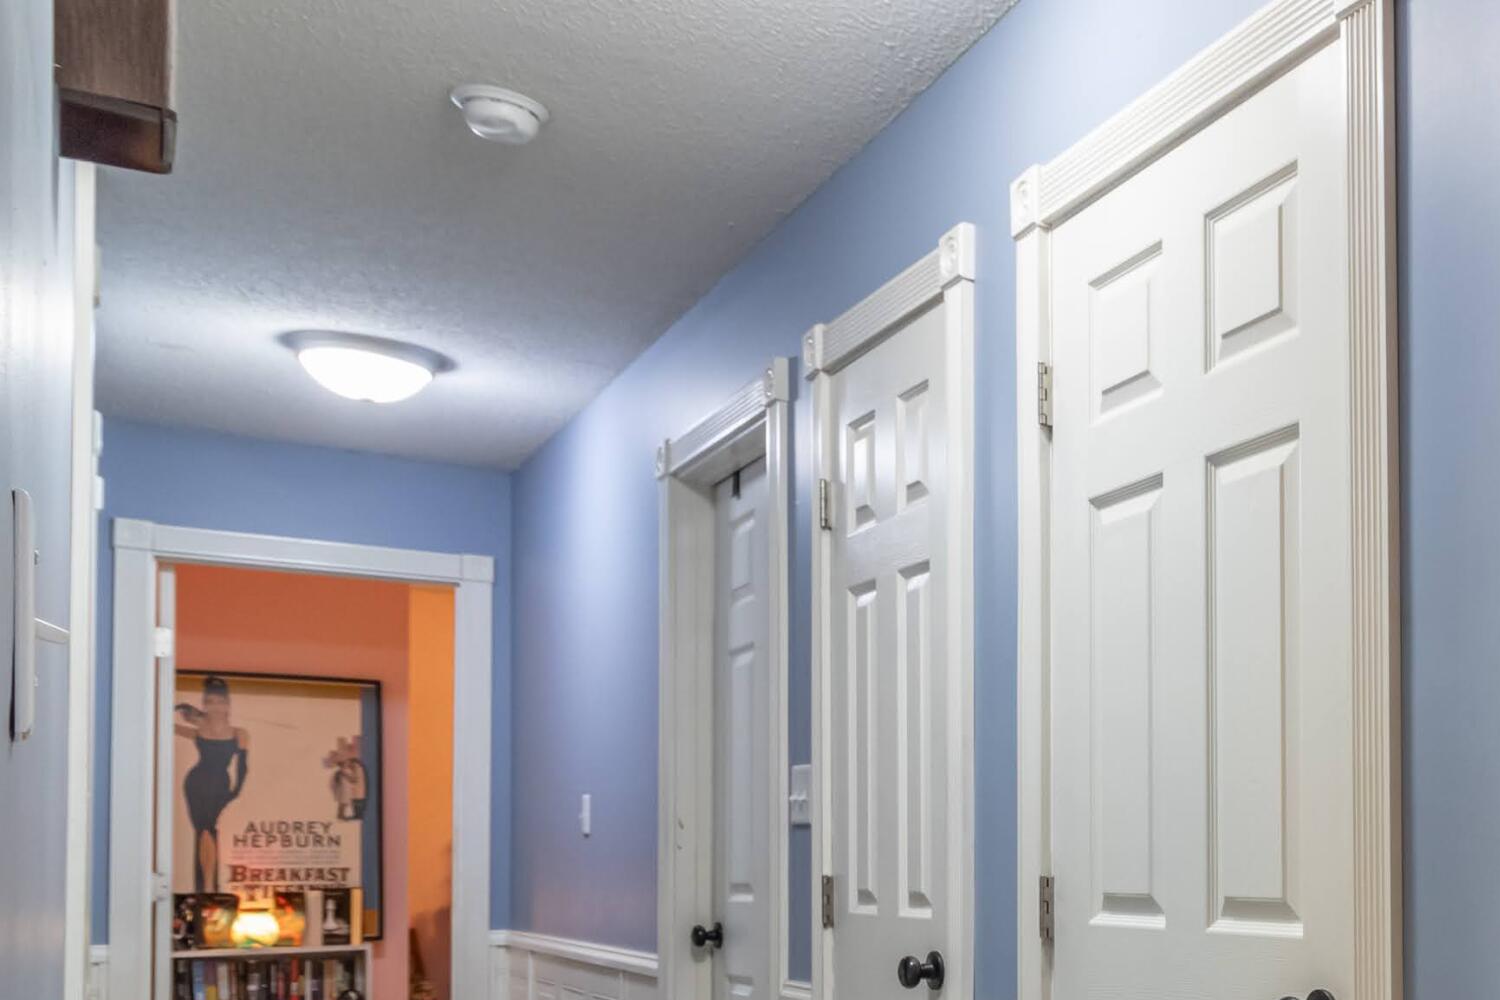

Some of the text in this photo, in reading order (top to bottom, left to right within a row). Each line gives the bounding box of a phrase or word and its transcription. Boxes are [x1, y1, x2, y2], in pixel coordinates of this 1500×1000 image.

[245, 820, 334, 834] AUDREY
[233, 834, 341, 848] HEPBURN
[228, 864, 351, 883] BREAKFAST
